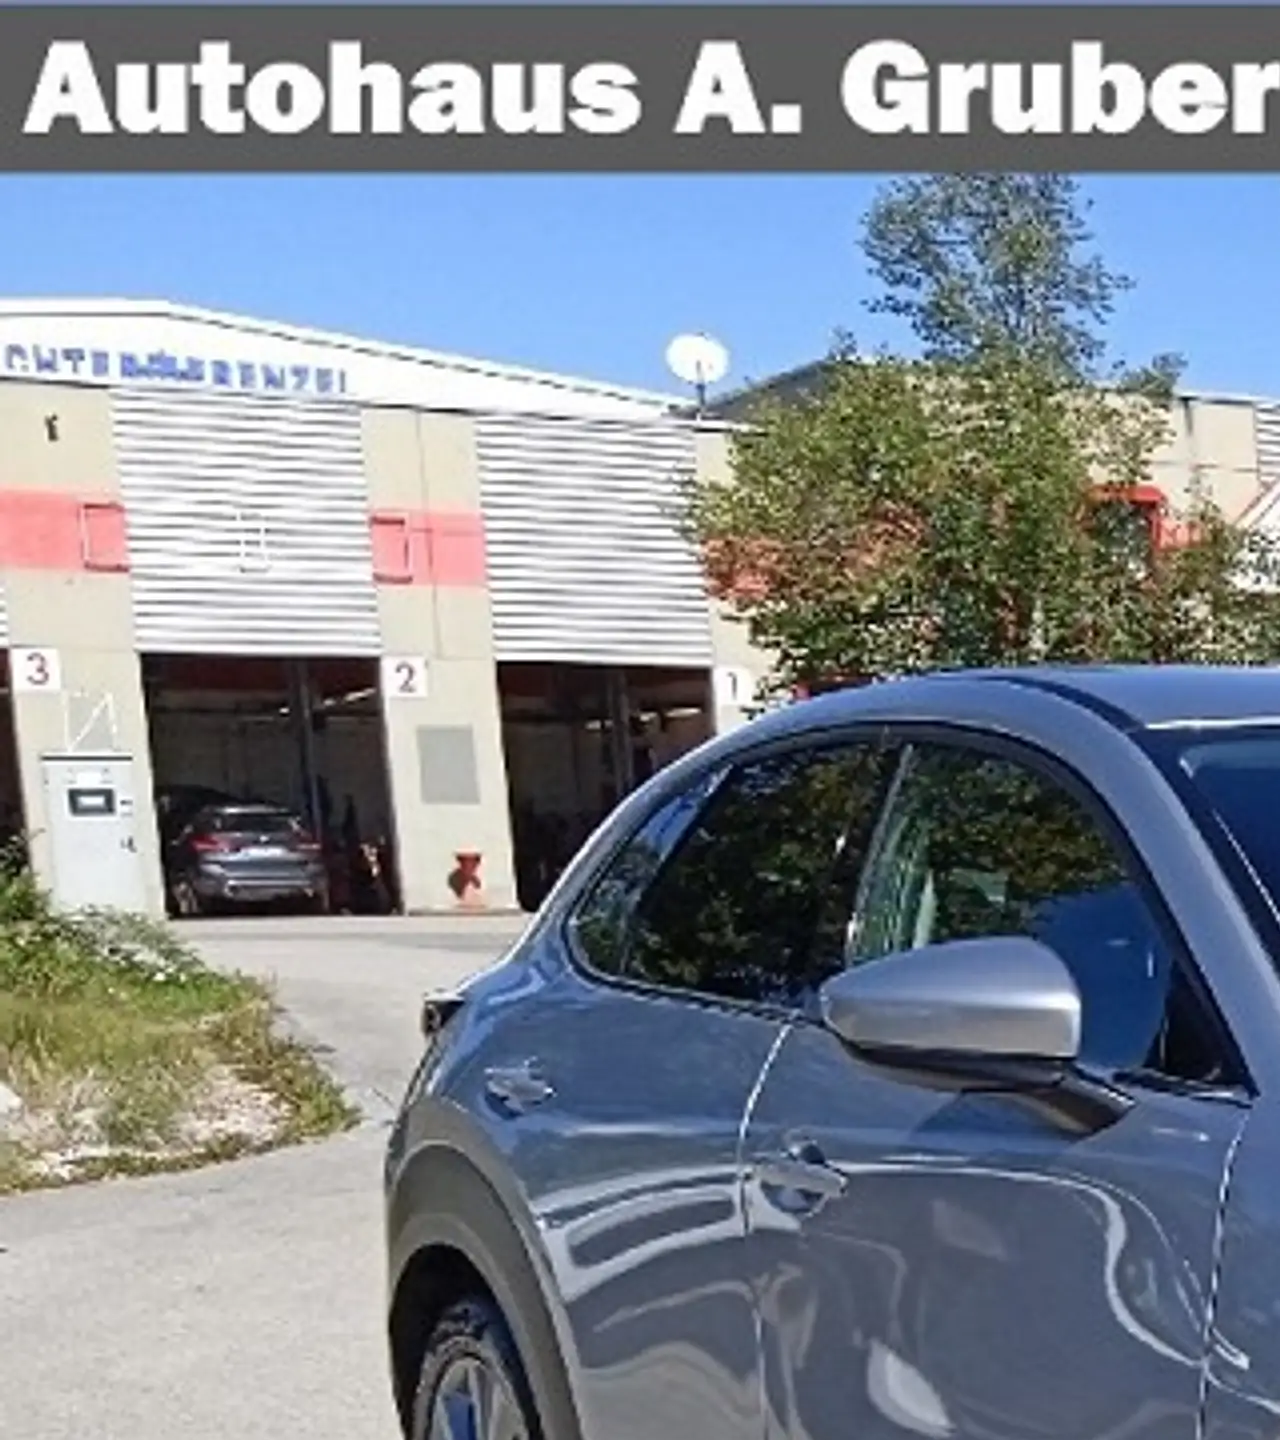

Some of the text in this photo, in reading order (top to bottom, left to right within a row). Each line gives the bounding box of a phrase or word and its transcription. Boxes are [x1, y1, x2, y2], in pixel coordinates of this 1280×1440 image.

[26, 652, 50, 686] 3
[394, 662, 417, 693] 2
[726, 671, 738, 700] 1
